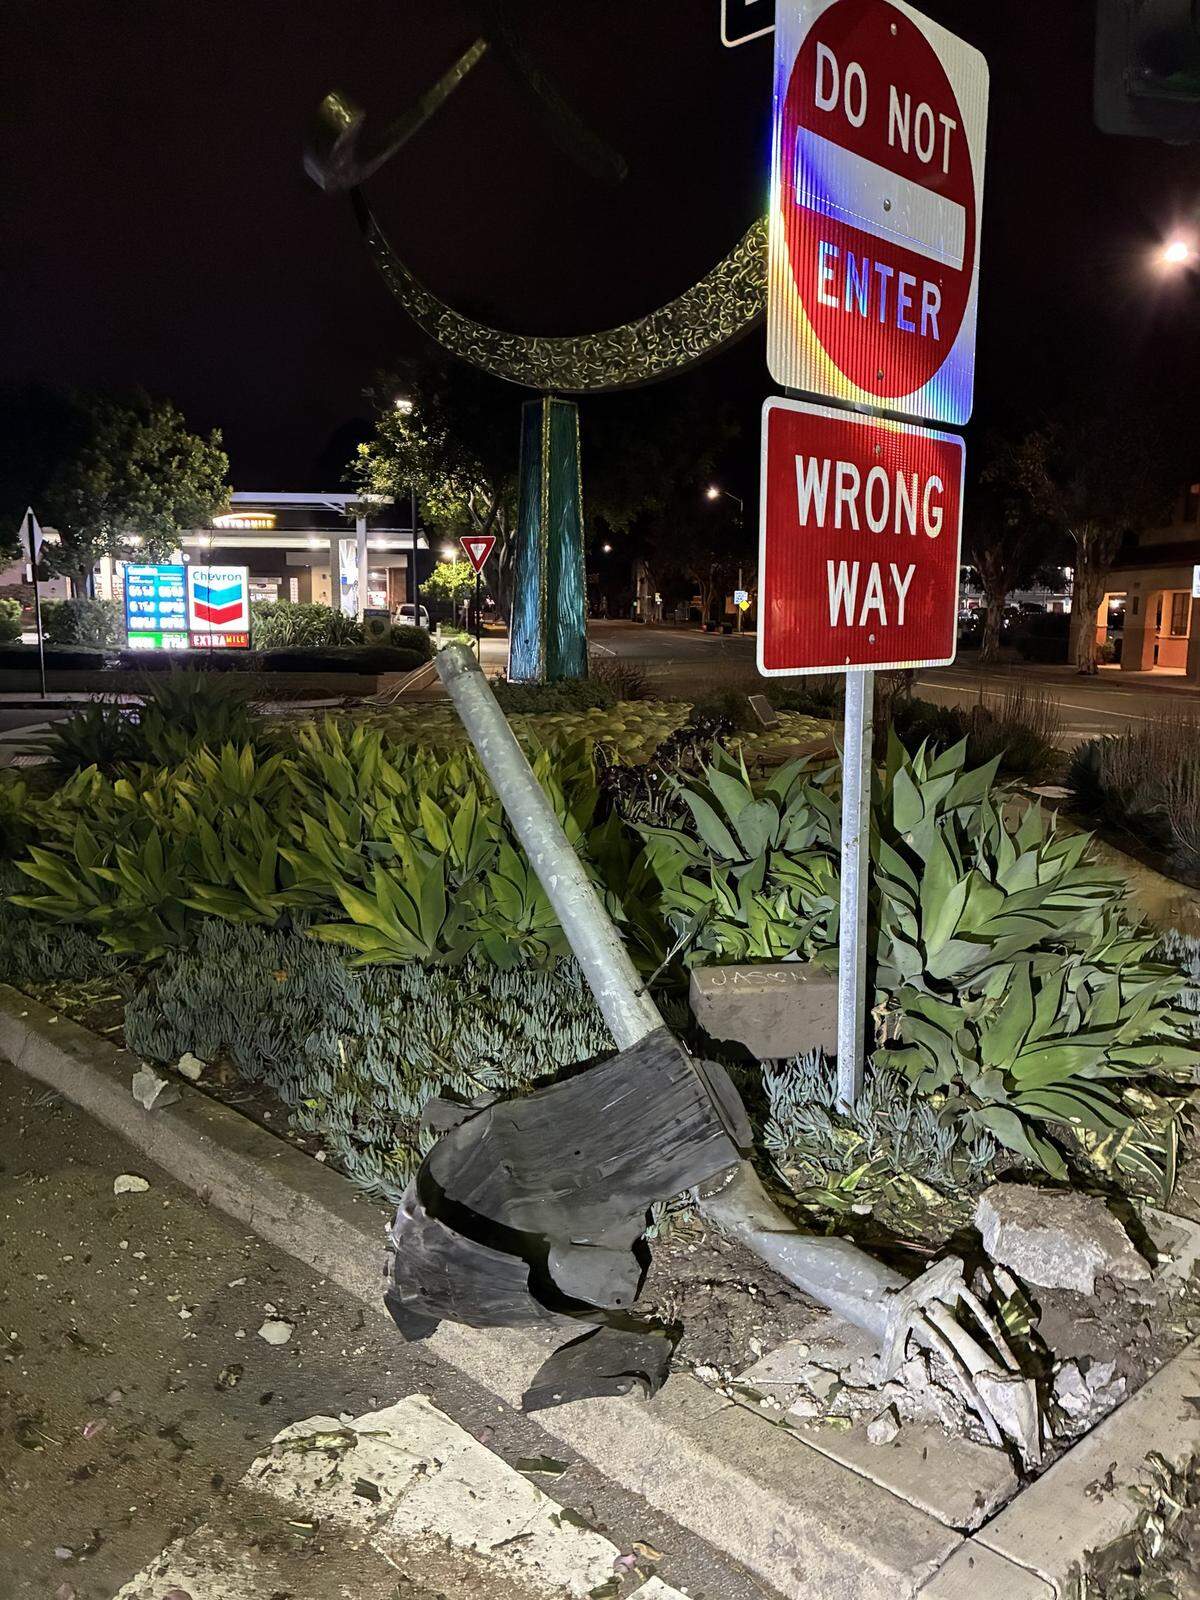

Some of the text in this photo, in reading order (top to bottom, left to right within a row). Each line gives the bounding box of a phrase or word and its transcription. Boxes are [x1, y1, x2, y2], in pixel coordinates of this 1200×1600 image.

[815, 41, 957, 175] DO NOT
[817, 240, 942, 339] ENTER
[795, 454, 944, 538] WRONG
[193, 571, 242, 581] Chevron
[827, 559, 917, 627] WAY
